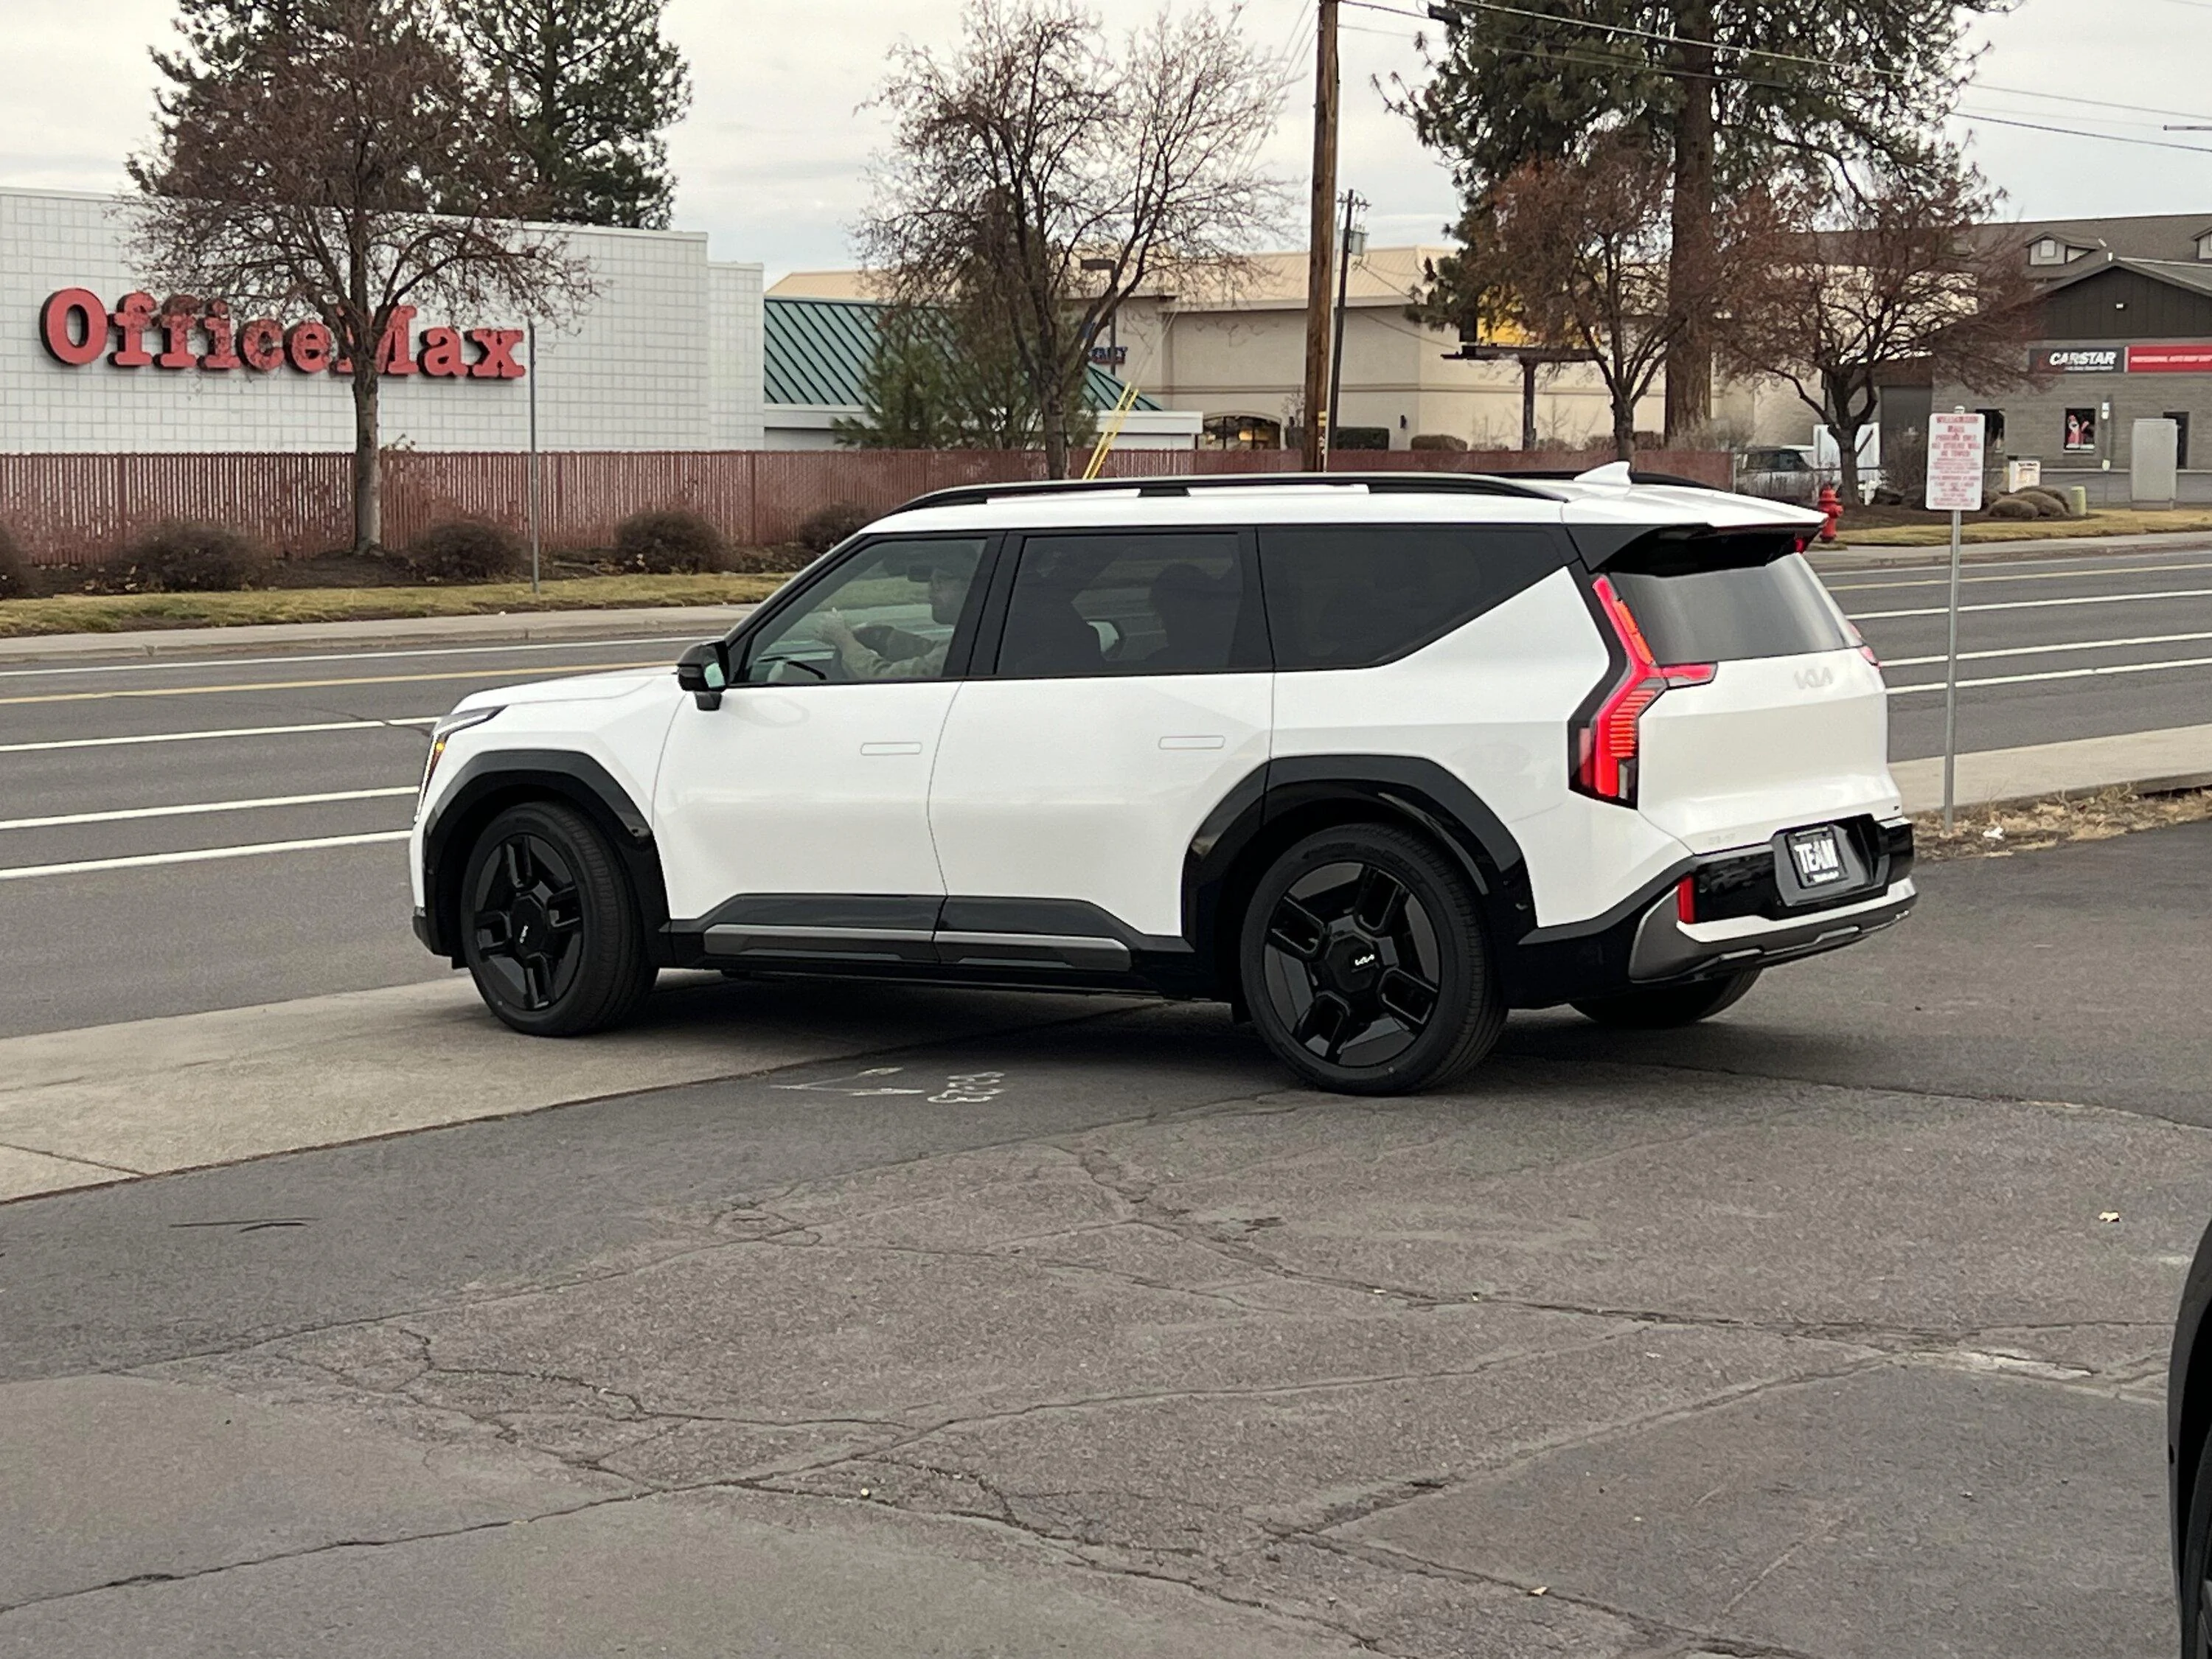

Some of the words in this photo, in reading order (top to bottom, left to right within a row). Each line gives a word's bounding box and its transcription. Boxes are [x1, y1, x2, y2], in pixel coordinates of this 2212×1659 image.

[41, 288, 526, 379] OfficeMax
[2049, 352, 2116, 366] CARSTAR
[1794, 838, 1839, 874] TEAM
